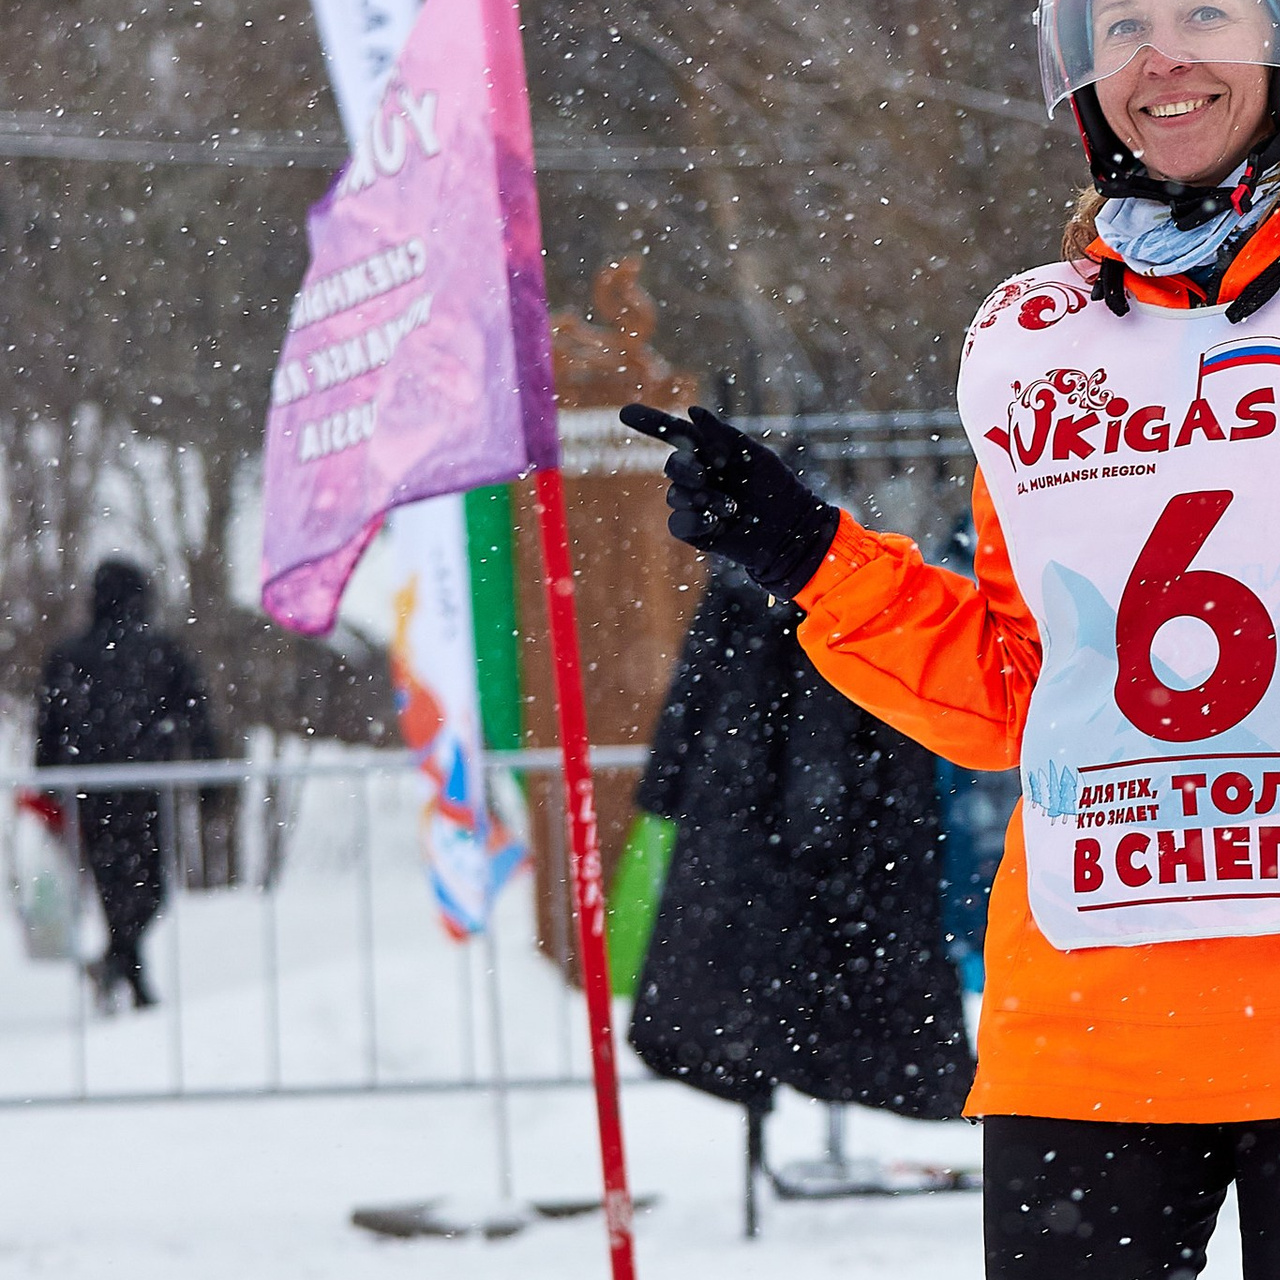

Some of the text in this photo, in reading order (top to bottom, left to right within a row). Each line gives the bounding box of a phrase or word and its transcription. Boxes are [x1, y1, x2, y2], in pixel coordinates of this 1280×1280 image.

[1030, 467, 1099, 491] MURMANSK
[1102, 463, 1156, 478] REGION
[1114, 489, 1277, 743] 6
[1079, 777, 1158, 809] ДЛЯ ТЕХ,
[1077, 804, 1160, 829] КТО ЗНАЕТ
[1073, 836, 1104, 893] В
